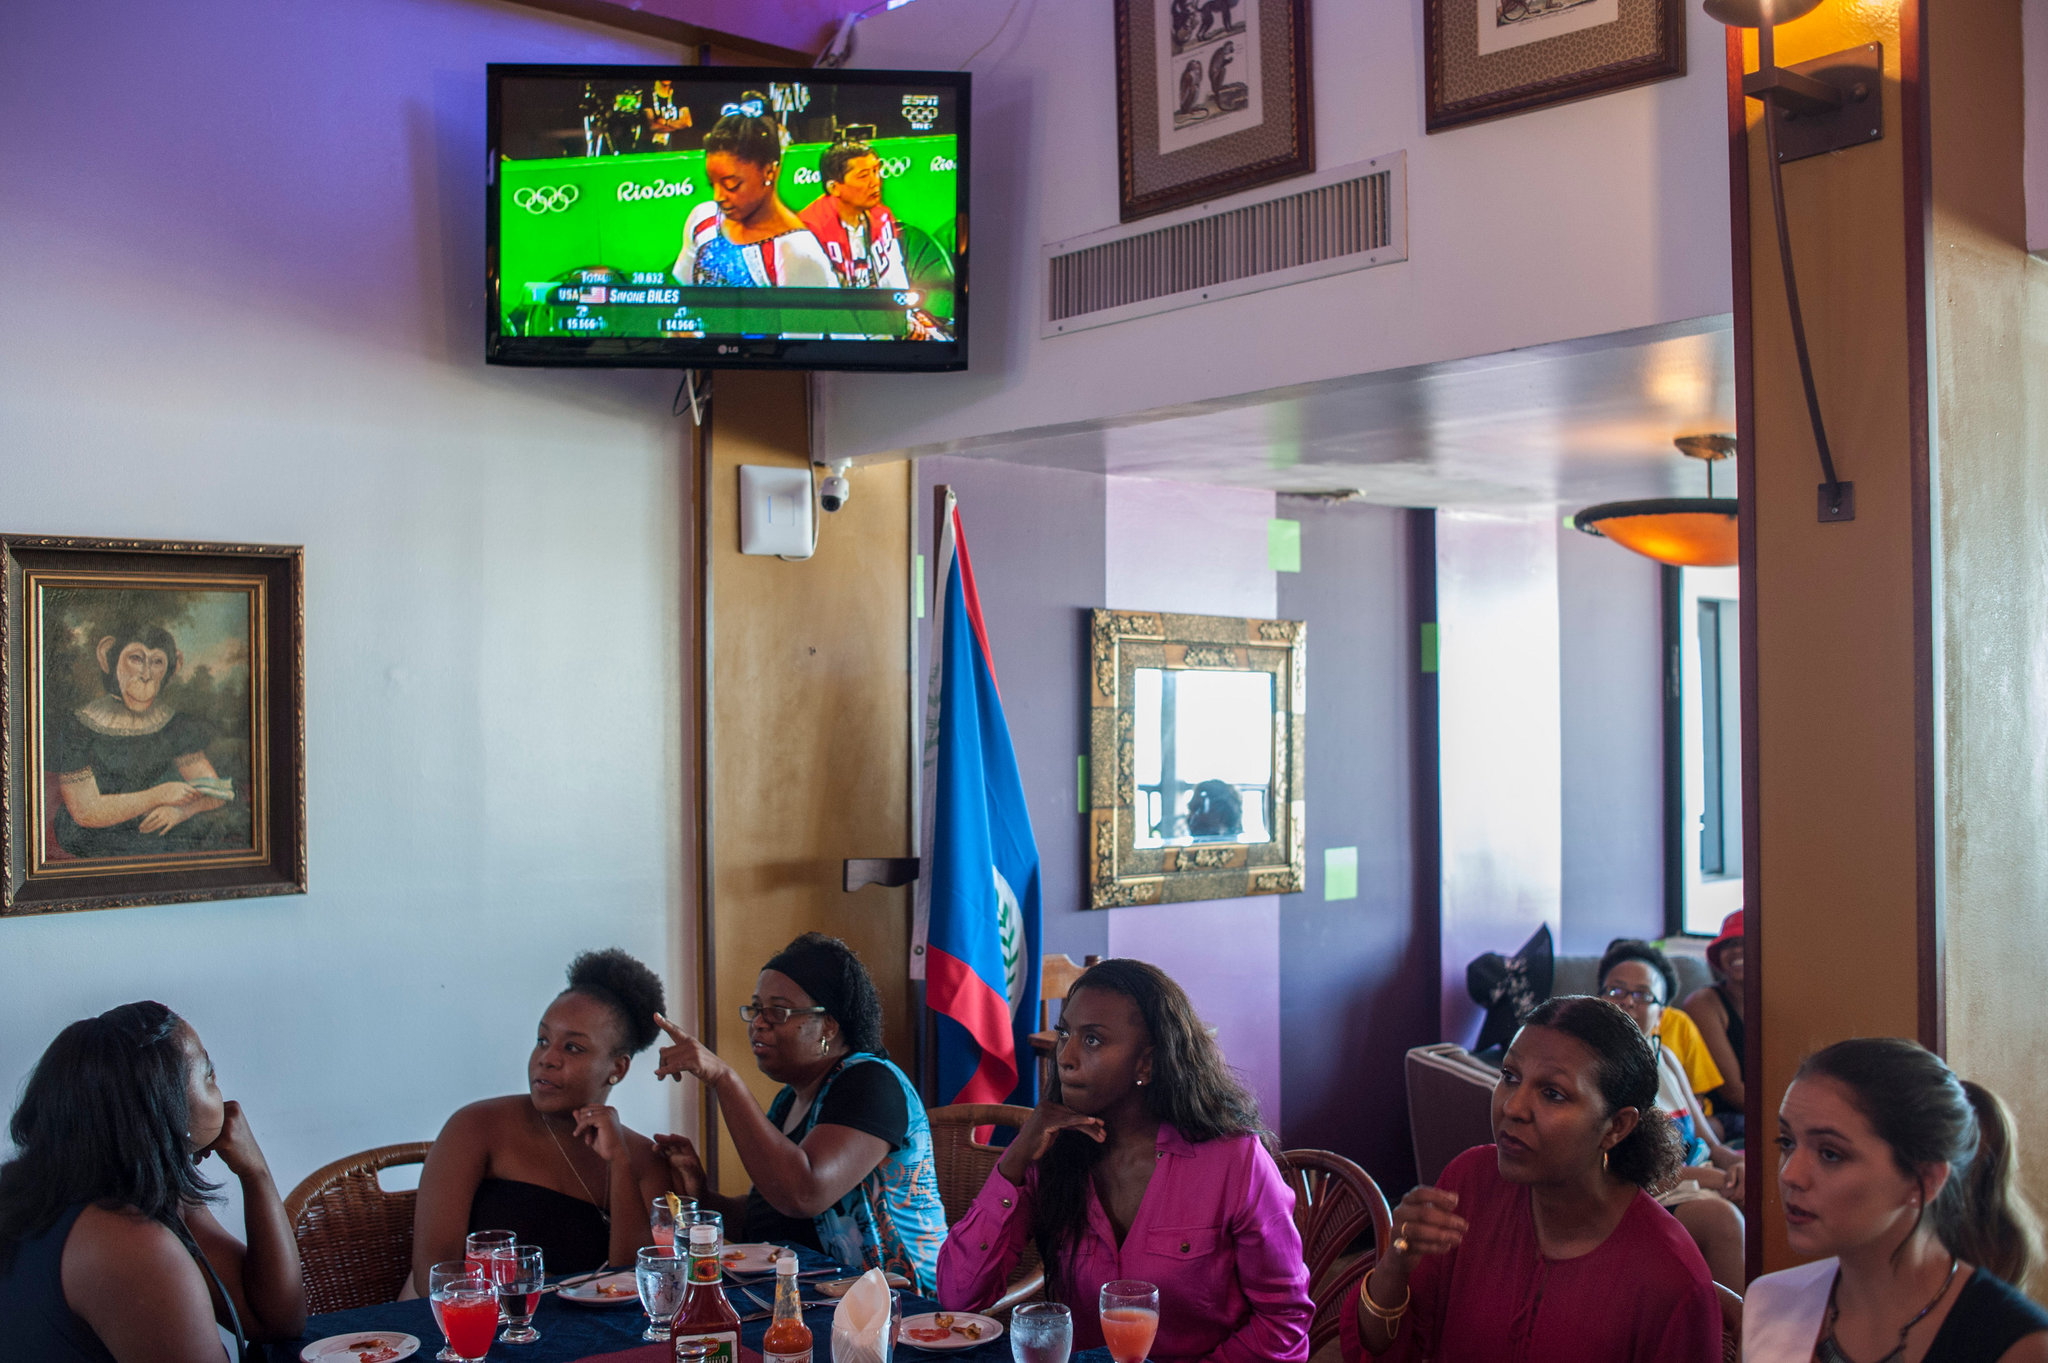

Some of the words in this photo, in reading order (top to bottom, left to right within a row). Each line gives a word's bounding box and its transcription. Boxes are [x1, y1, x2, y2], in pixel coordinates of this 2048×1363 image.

[902, 95, 939, 106] ESPN
[617, 177, 694, 202] Rio2016
[558, 288, 579, 301] USA
[647, 288, 680, 304] BILES
